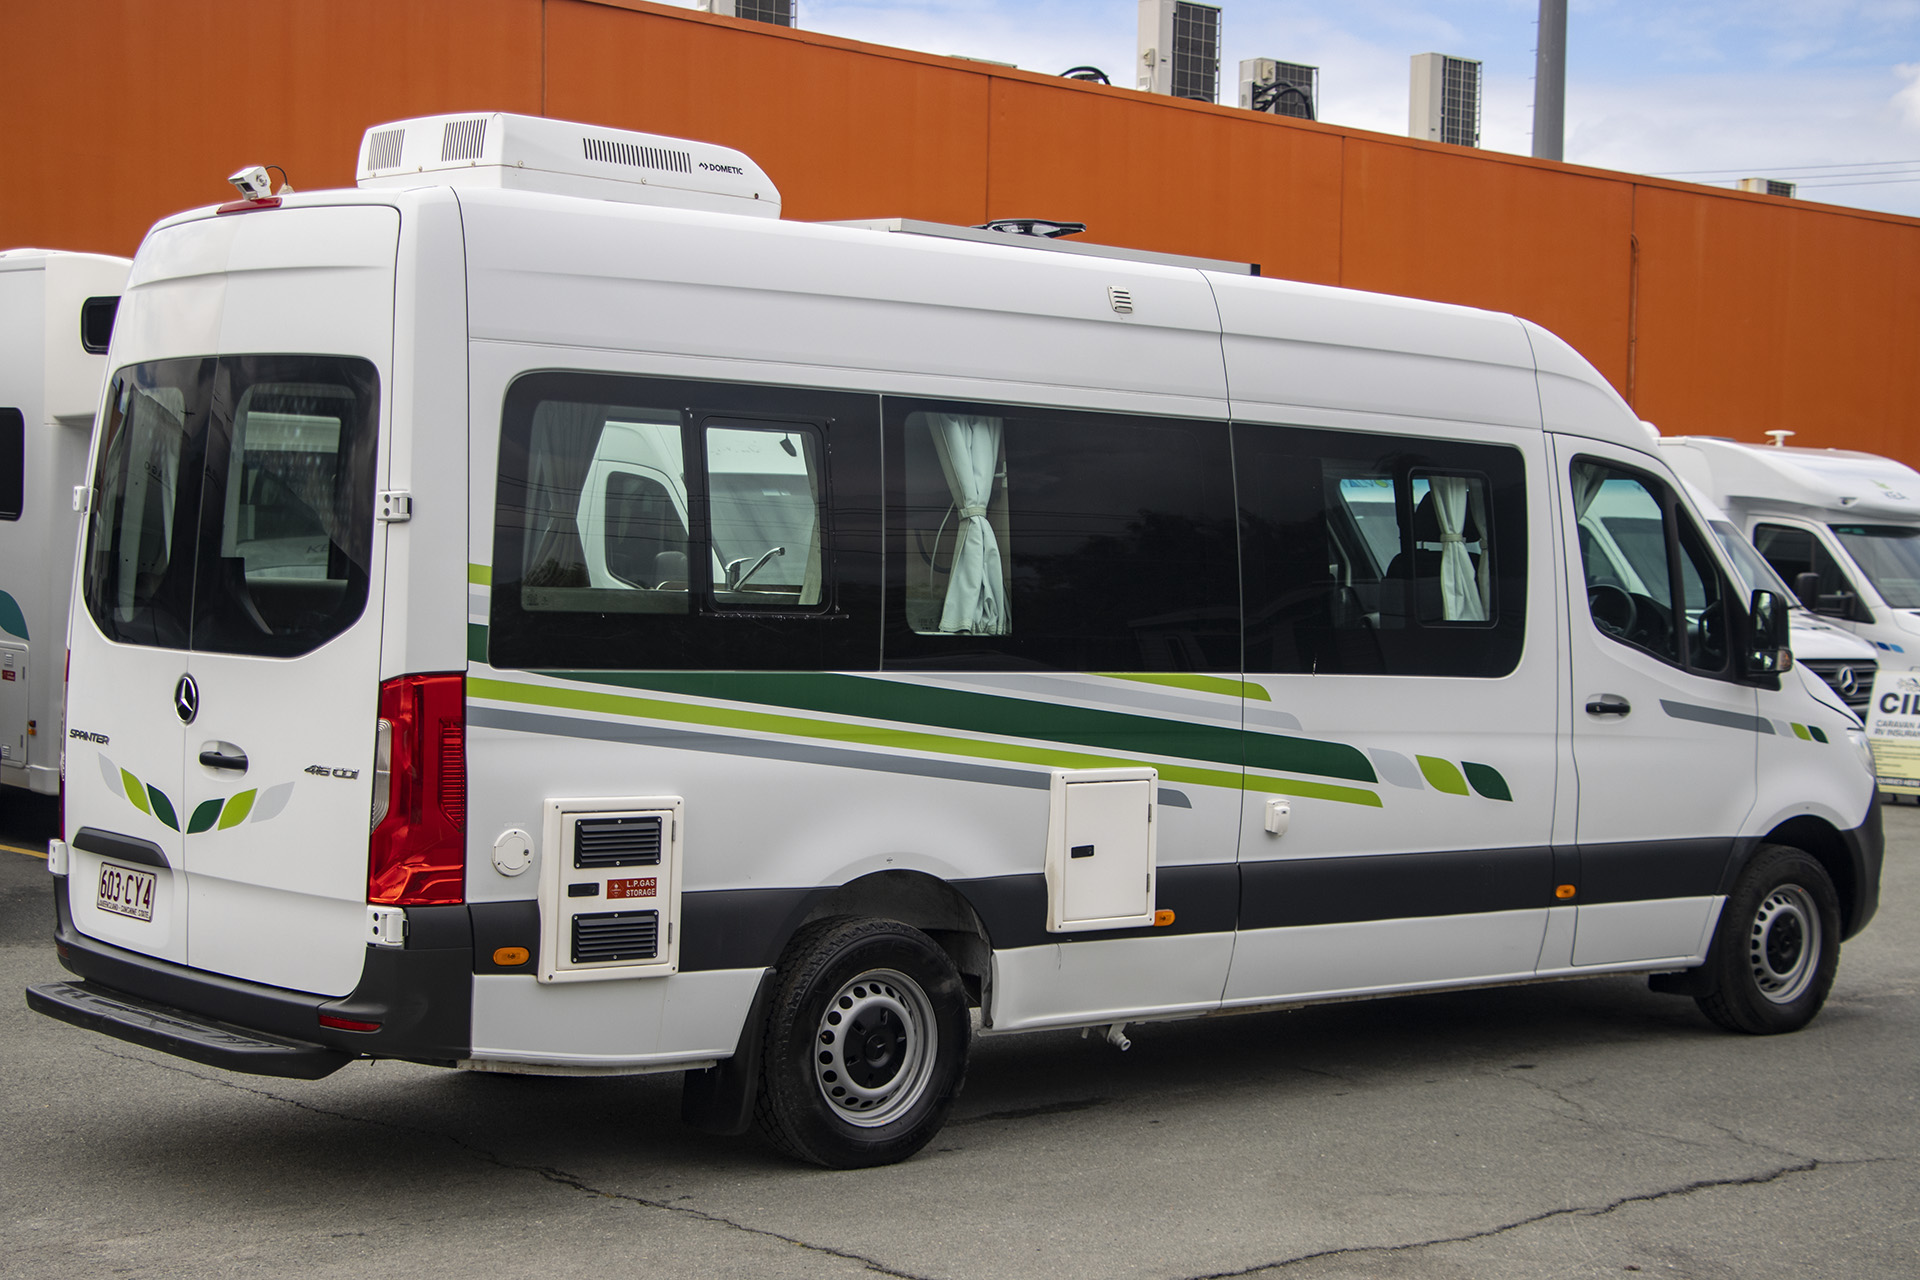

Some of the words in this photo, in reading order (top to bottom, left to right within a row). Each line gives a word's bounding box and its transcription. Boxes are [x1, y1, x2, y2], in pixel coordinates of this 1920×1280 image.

[709, 163, 743, 175] DOMETIC
[69, 728, 110, 745] SPRINTER
[304, 764, 331, 776] 416
[332, 767, 360, 780] CDI
[625, 888, 656, 897] STORAGE
